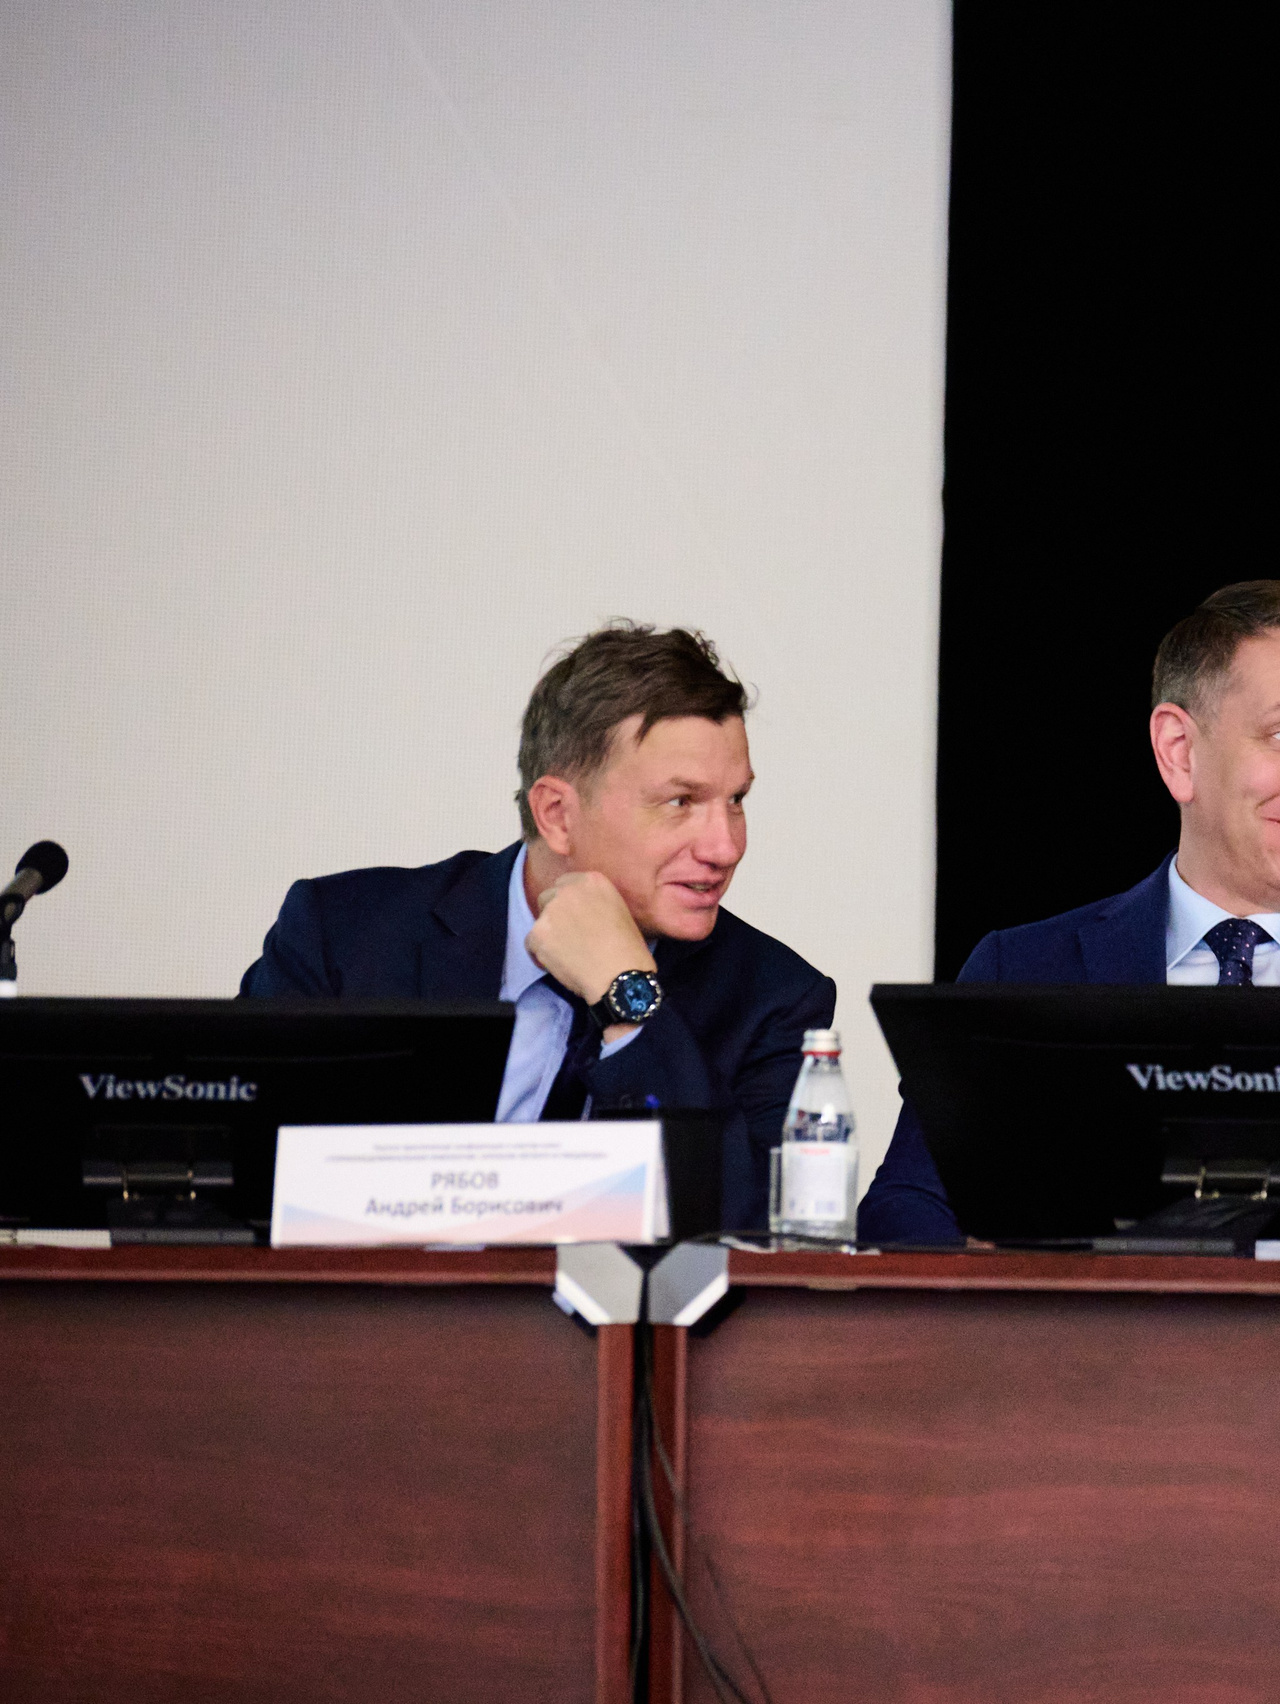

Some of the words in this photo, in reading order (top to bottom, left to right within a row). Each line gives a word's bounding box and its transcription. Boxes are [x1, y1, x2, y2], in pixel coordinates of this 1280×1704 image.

[79, 1073, 258, 1103] ViewSonic
[430, 1171, 500, 1190] РЯБОВ
[364, 1196, 444, 1218] Андрей
[450, 1197, 563, 1218] Борисович
